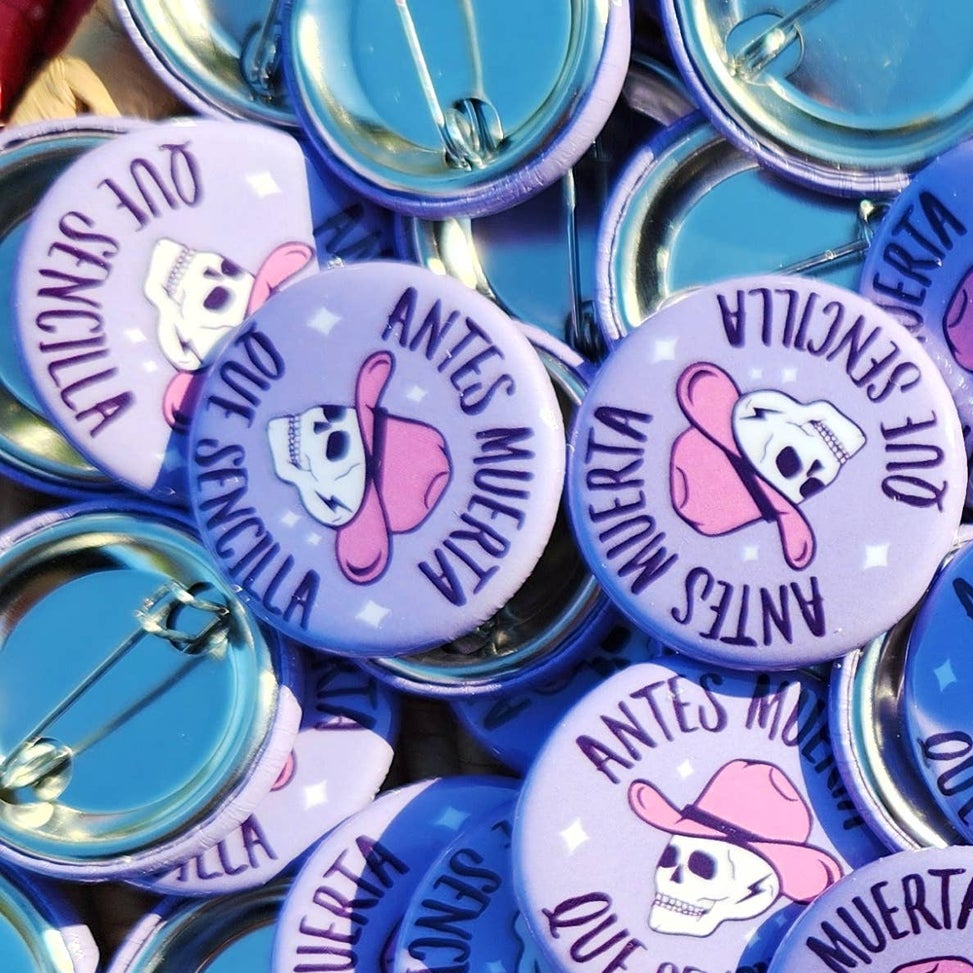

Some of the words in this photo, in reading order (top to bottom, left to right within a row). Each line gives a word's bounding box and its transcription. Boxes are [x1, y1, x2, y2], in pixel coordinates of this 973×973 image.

[98, 141, 204, 232] QUE
[35, 211, 136, 438] SENCILLA
[206, 323, 285, 429] QUE
[382, 287, 516, 417] ANTES
[718, 288, 920, 402] SENCILLA
[418, 427, 536, 607] MUERTA
[586, 406, 678, 595] MUERTA
[881, 410, 947, 511] QUE
[195, 439, 320, 630] SENCILLA
[672, 567, 826, 646] ANTES
[575, 674, 729, 785] ANTES
